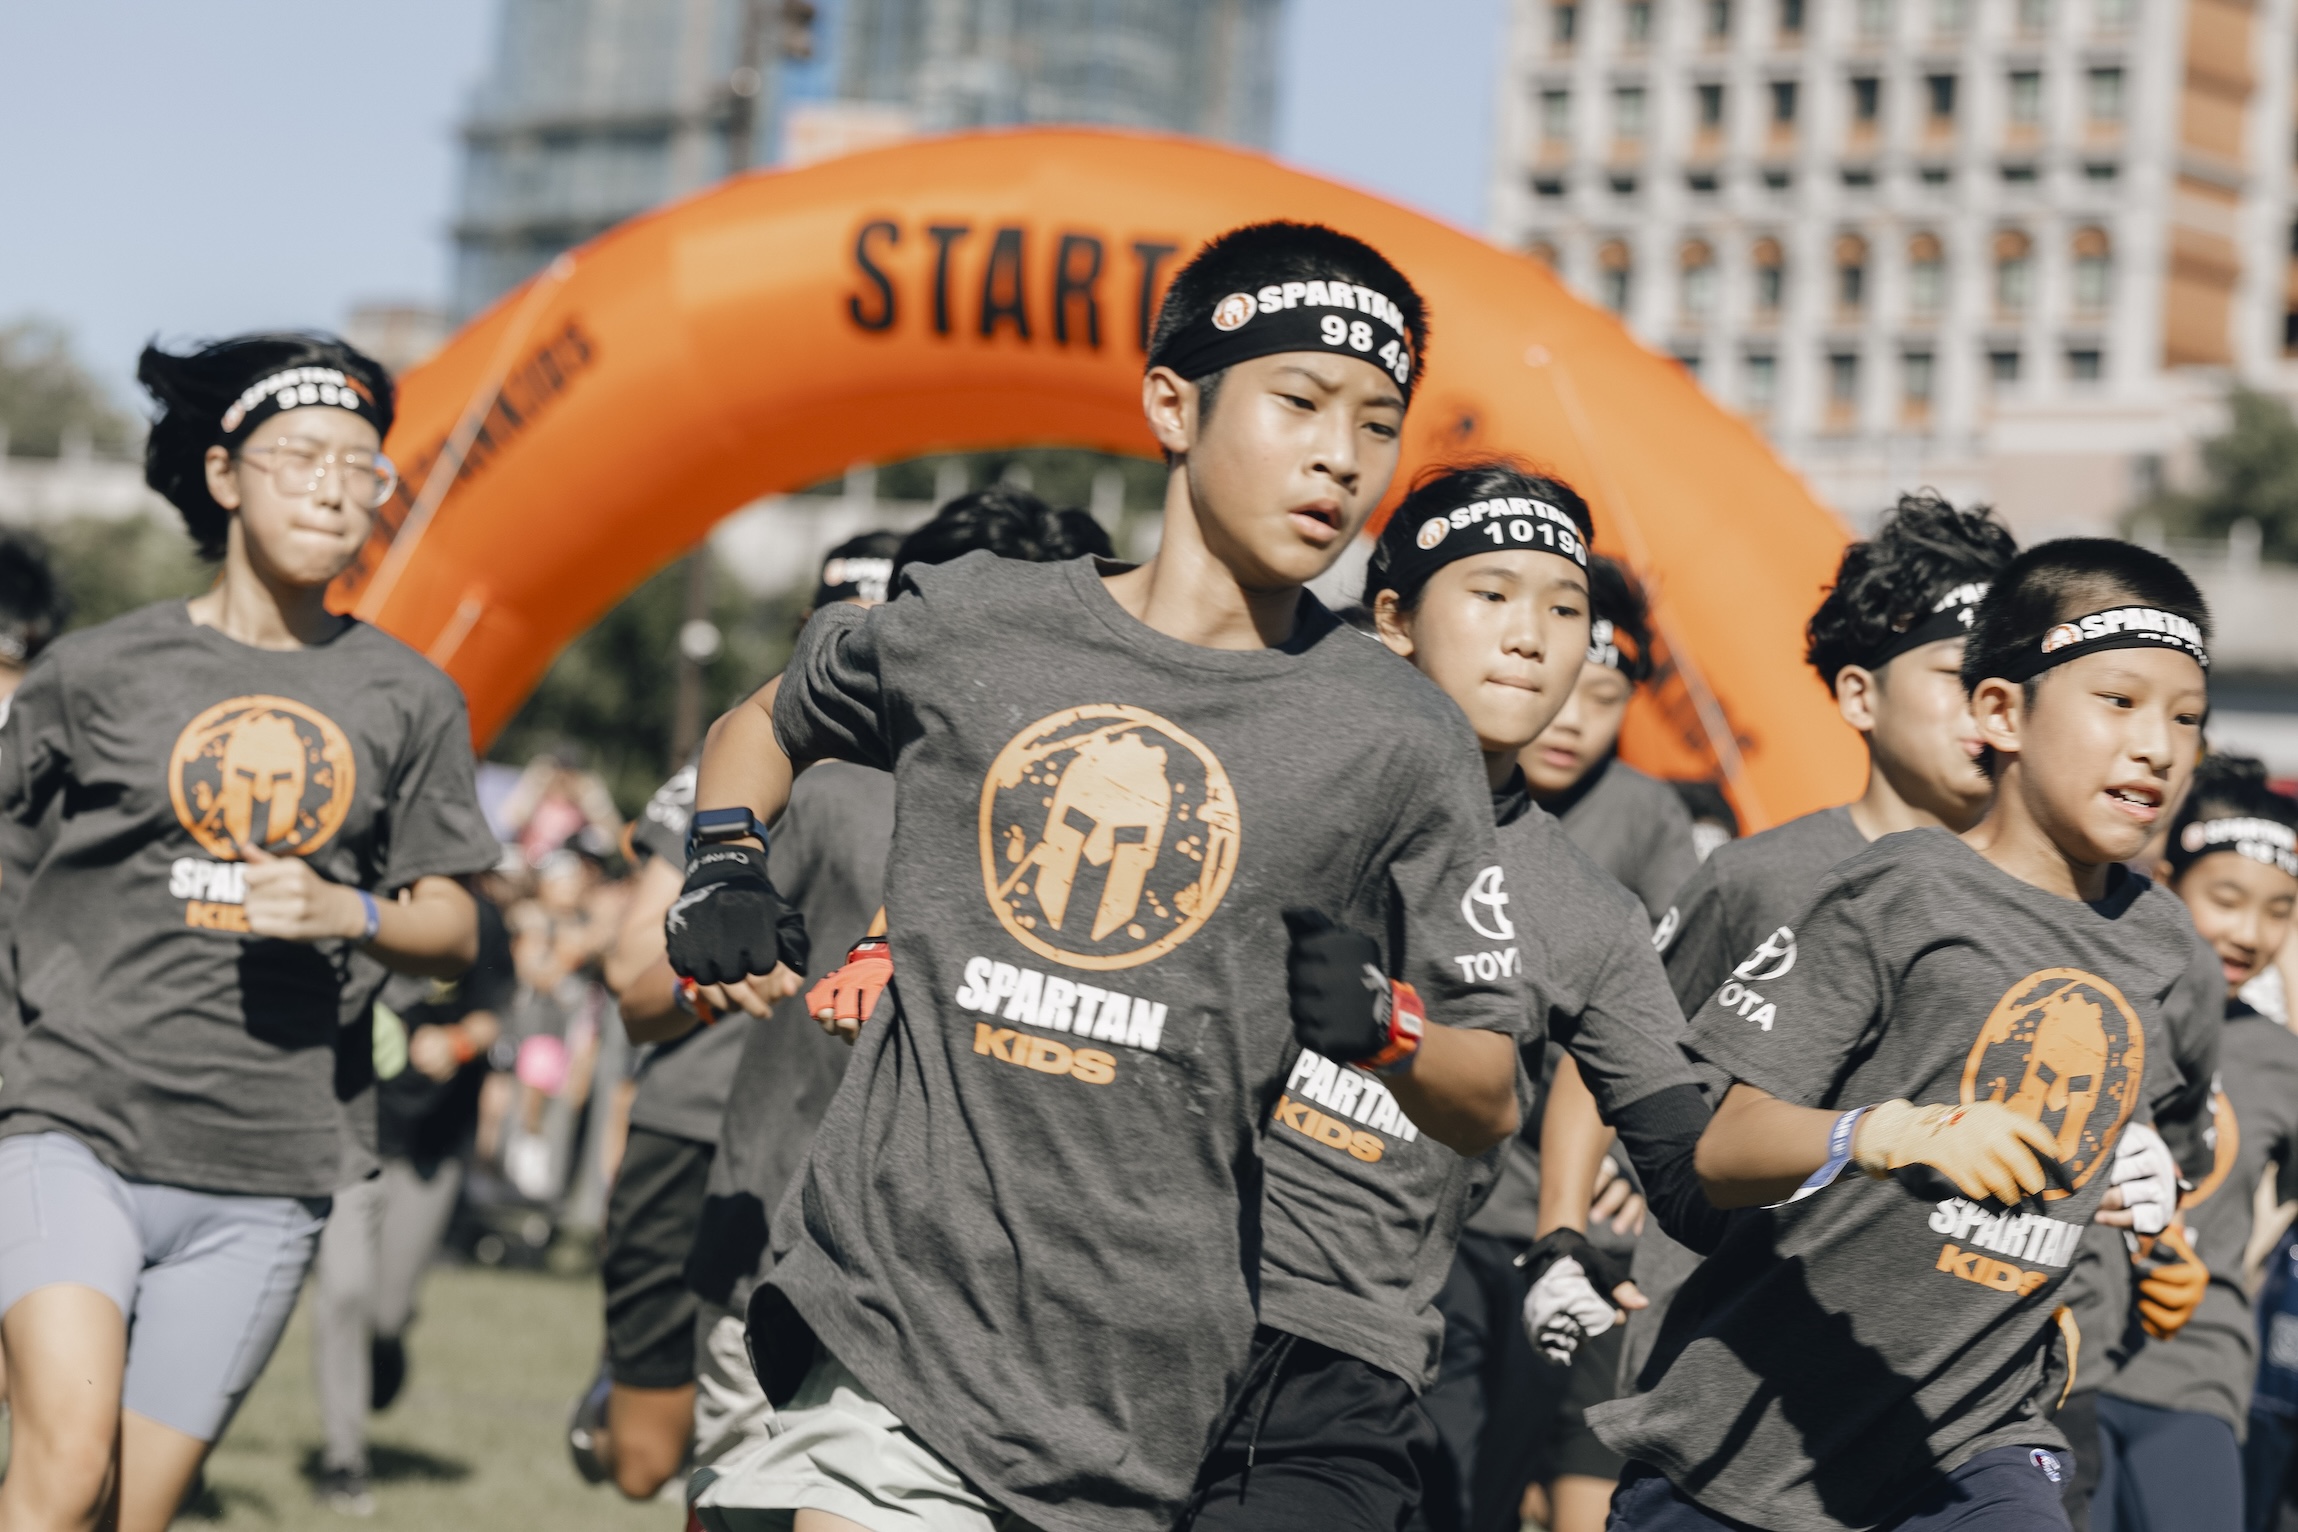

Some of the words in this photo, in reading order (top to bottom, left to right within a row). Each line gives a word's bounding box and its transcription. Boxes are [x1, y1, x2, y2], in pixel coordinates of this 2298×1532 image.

[849, 219, 1178, 354] START
[1257, 279, 1404, 336] SPARTAN
[1449, 497, 1579, 536] SPARTAN
[2080, 607, 2203, 650] SPARTAN
[1453, 946, 1522, 984] TOY
[955, 955, 1169, 1051] SPARTAN
[1717, 979, 1778, 1032] OTA
[973, 1021, 1118, 1085] KIDS
[1285, 1046, 1419, 1143] PARTAN
[1273, 1093, 1386, 1163] KIDS
[1927, 1195, 2085, 1268] SPARTAN
[1935, 1243, 2049, 1297] KIDS
